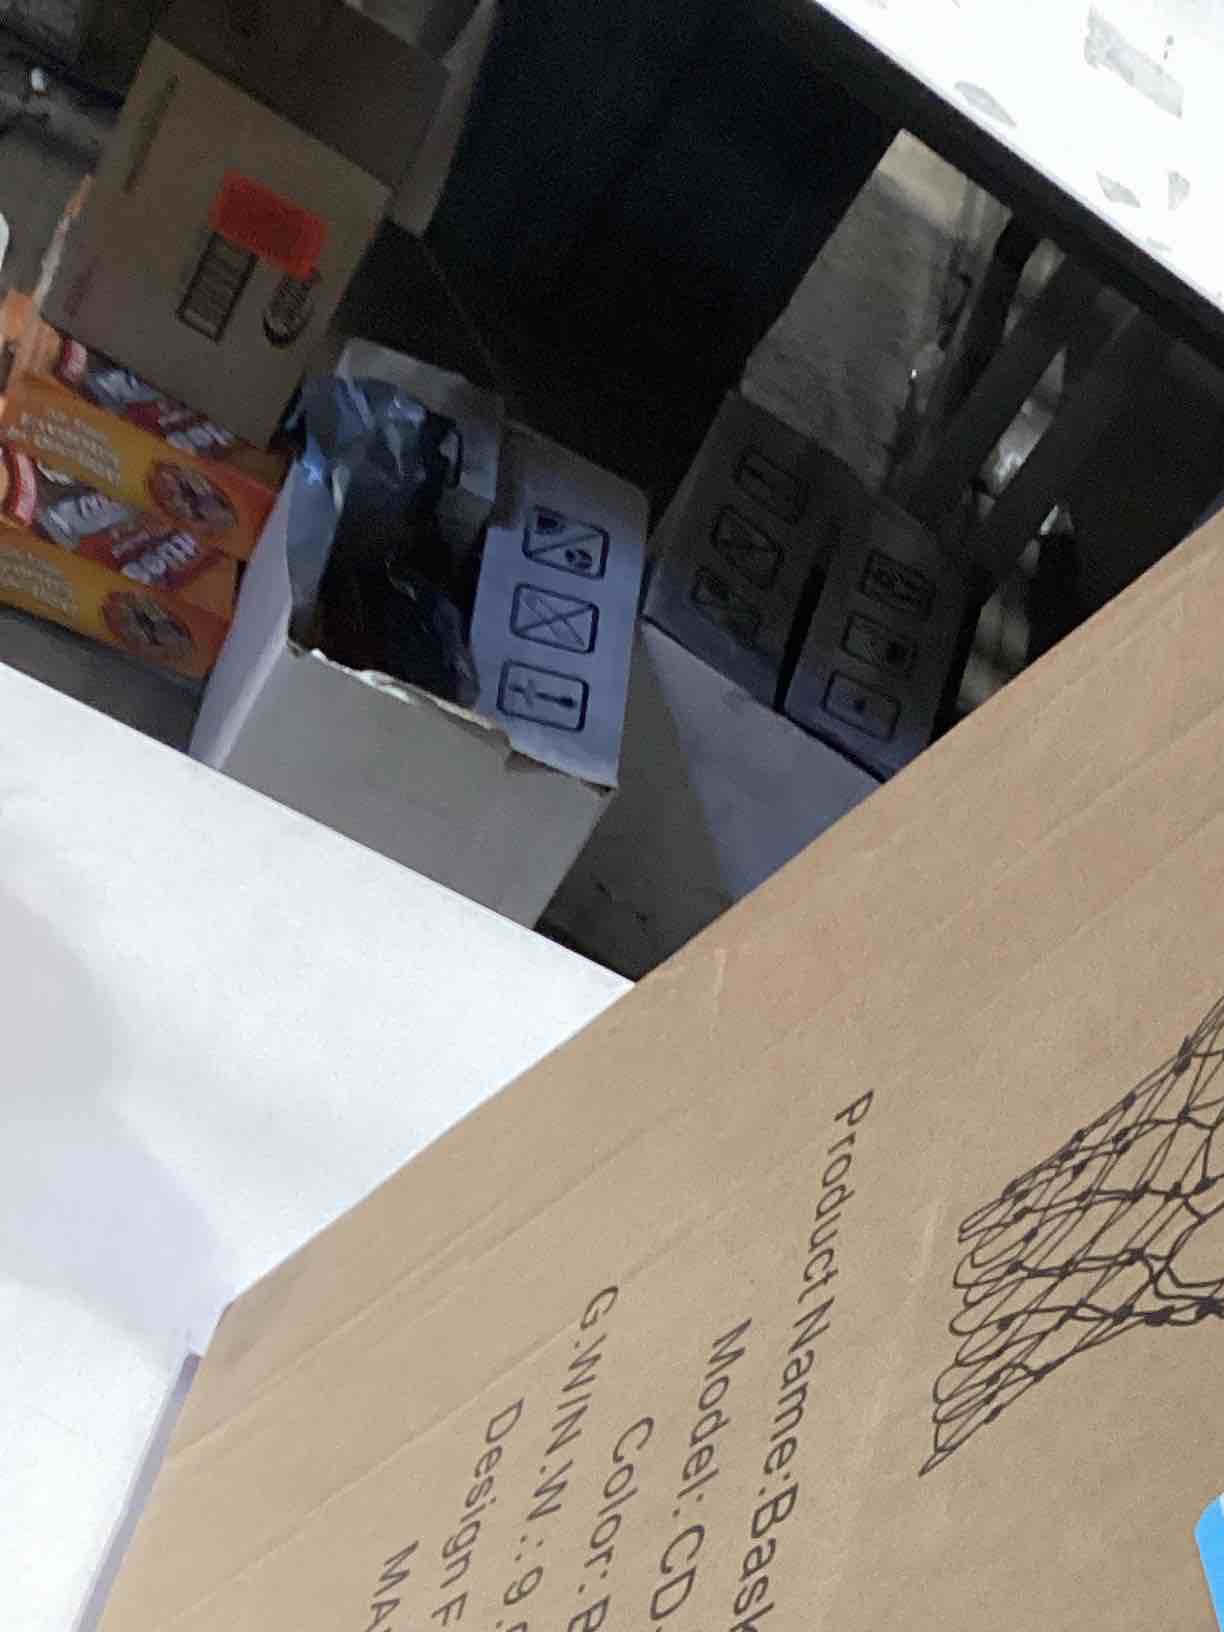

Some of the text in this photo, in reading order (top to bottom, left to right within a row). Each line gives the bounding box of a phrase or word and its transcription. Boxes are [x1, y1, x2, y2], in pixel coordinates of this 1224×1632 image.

[797, 1089, 875, 1305] Product
[439, 1397, 525, 1589] Design
[577, 1416, 655, 1594] Color:
[672, 1317, 753, 1518] Model:
